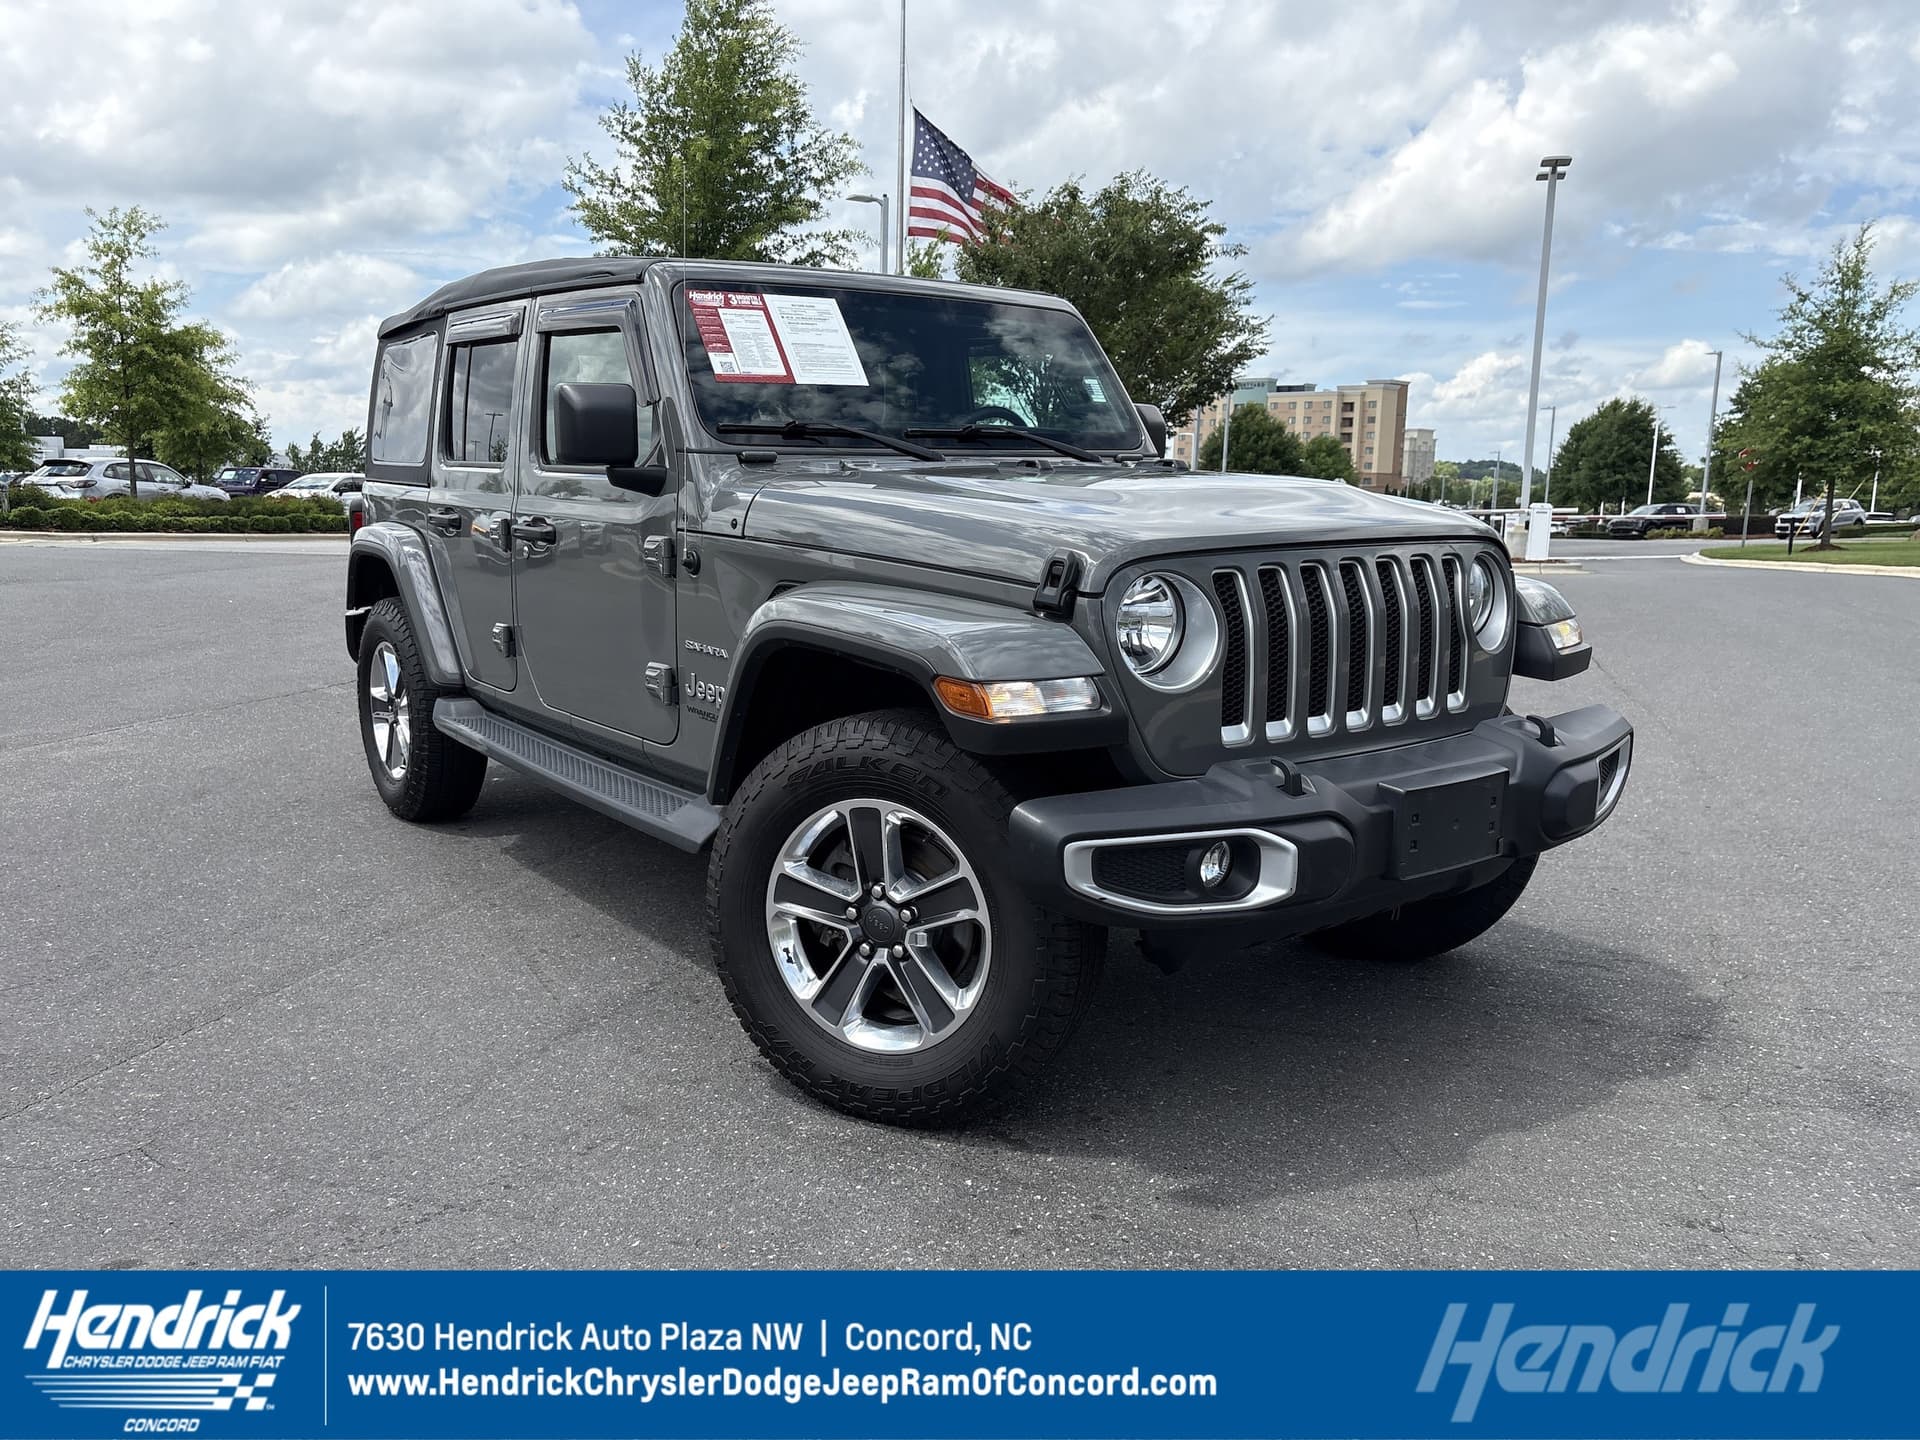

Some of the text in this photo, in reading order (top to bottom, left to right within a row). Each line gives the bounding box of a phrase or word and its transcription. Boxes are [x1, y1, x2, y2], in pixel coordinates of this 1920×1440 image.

[689, 290, 725, 302] Hendrick
[728, 294, 737, 305] 3
[685, 640, 728, 659] SAHARA
[685, 672, 725, 711] Jeep
[782, 756, 949, 799] FALKEN
